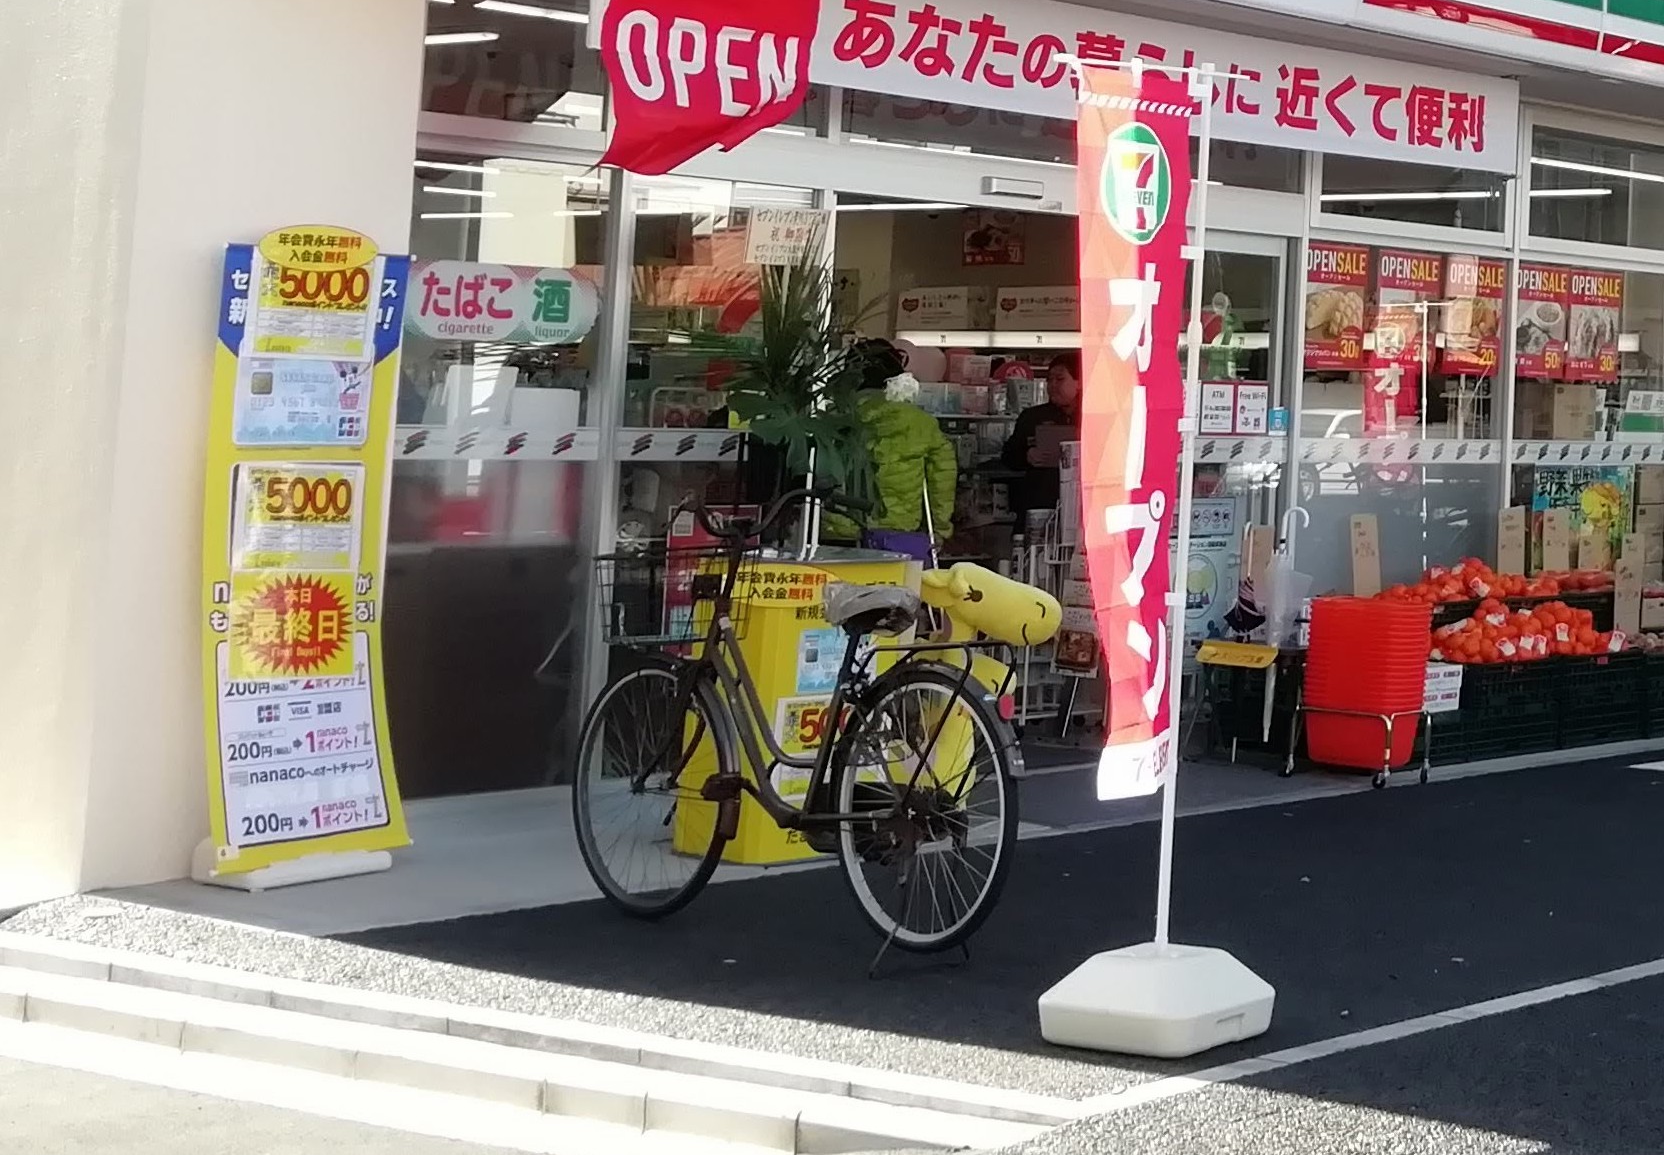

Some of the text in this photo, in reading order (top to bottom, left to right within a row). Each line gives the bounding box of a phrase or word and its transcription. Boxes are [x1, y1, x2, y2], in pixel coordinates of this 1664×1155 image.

[616, 8, 800, 118] OPEN
[1274, 63, 1486, 154] 近くて便利
[278, 233, 362, 249] 年会費永年無料
[289, 249, 348, 264] 入会金無料
[279, 266, 370, 303] 5000
[420, 271, 572, 323] たばこ 酒
[437, 320, 494, 335] cigarette
[534, 325, 571, 340] liquor
[266, 477, 352, 515] 5000
[1106, 262, 1166, 721] オープン
[284, 588, 312, 604] 本日
[750, 587, 814, 601] 入会金無料
[253, 607, 339, 644] 最終日
[227, 741, 273, 763] 200円
[241, 812, 293, 837] 200円
